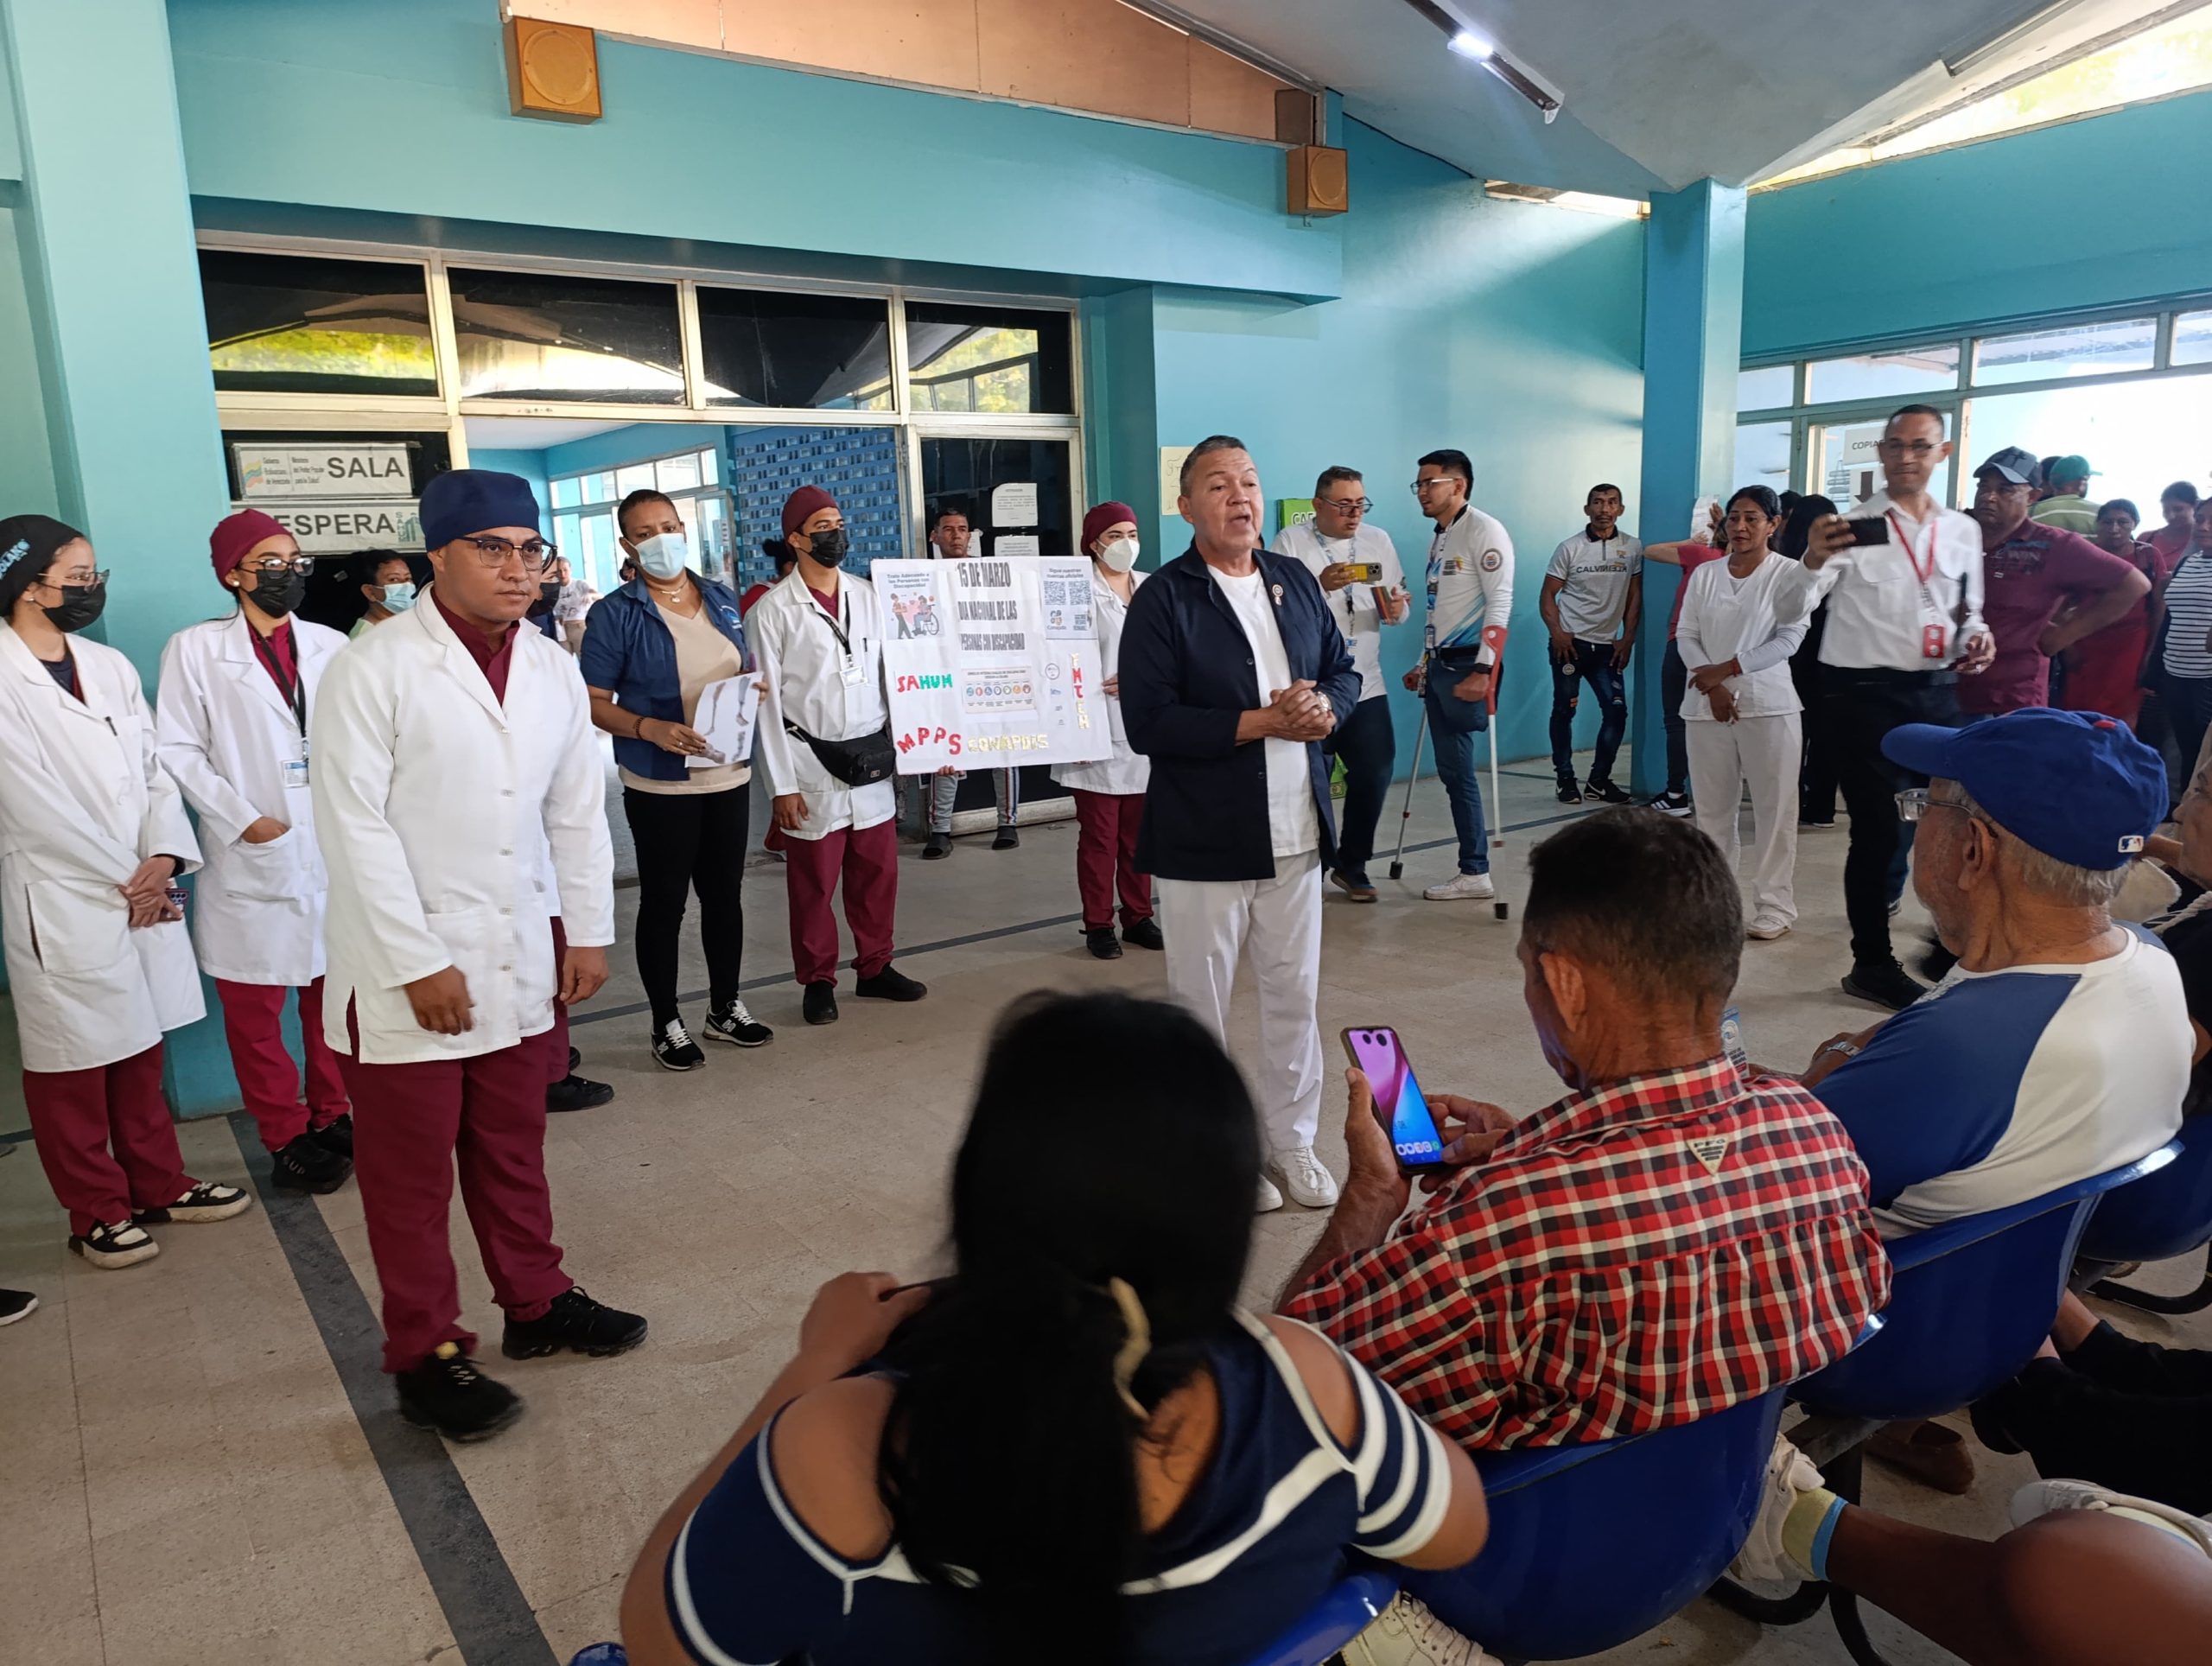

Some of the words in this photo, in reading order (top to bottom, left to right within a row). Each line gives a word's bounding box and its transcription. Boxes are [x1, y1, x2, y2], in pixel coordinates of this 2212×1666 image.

[327, 457, 405, 479] SALA
[957, 562, 969, 588] 15
[969, 562, 982, 588] DE
[981, 562, 1012, 588] MARZO
[897, 727, 962, 755] MPPS
